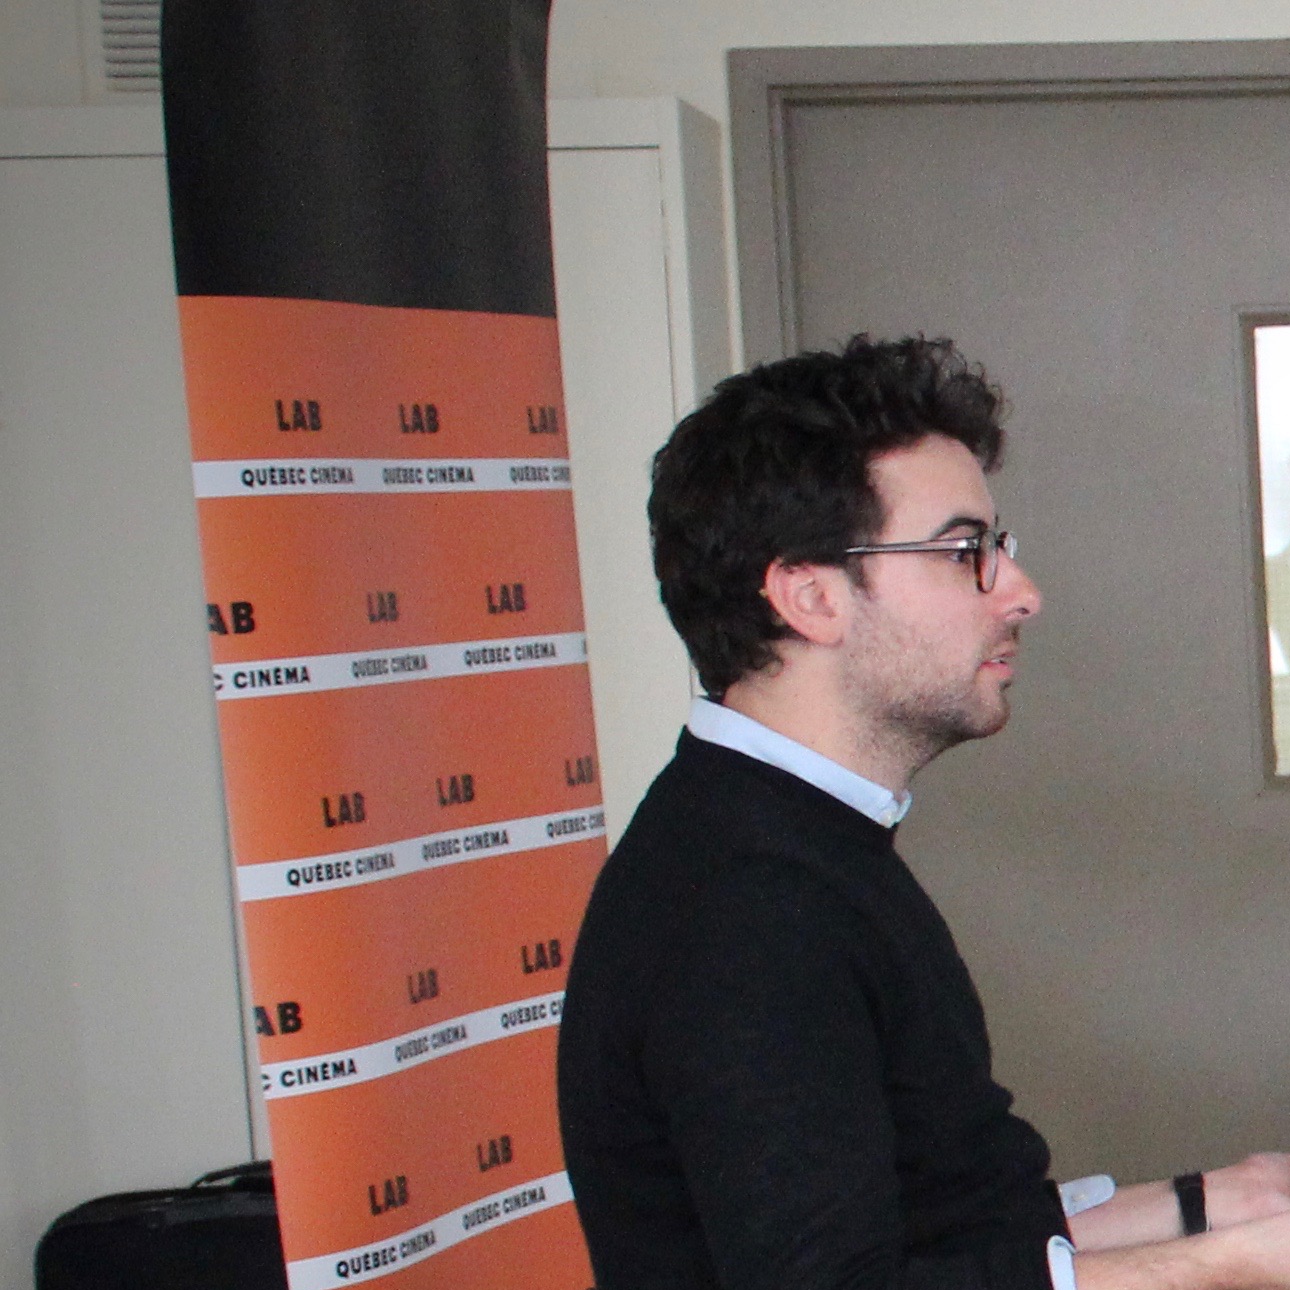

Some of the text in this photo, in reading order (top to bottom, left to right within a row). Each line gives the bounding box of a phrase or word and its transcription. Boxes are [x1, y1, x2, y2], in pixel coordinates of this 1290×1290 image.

[275, 400, 322, 432] LAB
[400, 403, 440, 434] LAB
[526, 406, 558, 434] LAB
[241, 465, 353, 488] QUÉBEC CINÉMA
[426, 465, 475, 485] CINÉMA
[509, 465, 550, 484] QUÉBEC
[367, 591, 399, 623] LAB
[485, 583, 526, 615] LAB
[206, 600, 256, 636] AB
[463, 641, 557, 668] QUÉBEC CINÉMA
[233, 664, 312, 690] CINÉMA
[565, 756, 594, 787] LAB
[436, 774, 475, 807] LAB
[321, 792, 366, 828] LAB
[463, 829, 510, 852] CINÉMA
[547, 817, 587, 839] QUÉBEC
[287, 852, 395, 887] QUÉBEC CINÉMA
[521, 939, 562, 975] LAB
[407, 968, 440, 1005] LAB
[253, 1001, 302, 1036] AB
[501, 1004, 548, 1030] QUÉBEC
[281, 1058, 358, 1088] CINÉMA
[477, 1134, 513, 1172] LAB
[368, 1175, 409, 1217] LAB
[462, 1186, 546, 1231] QUÉBEC CINÉMA
[336, 1246, 397, 1279] QUÉBEC
